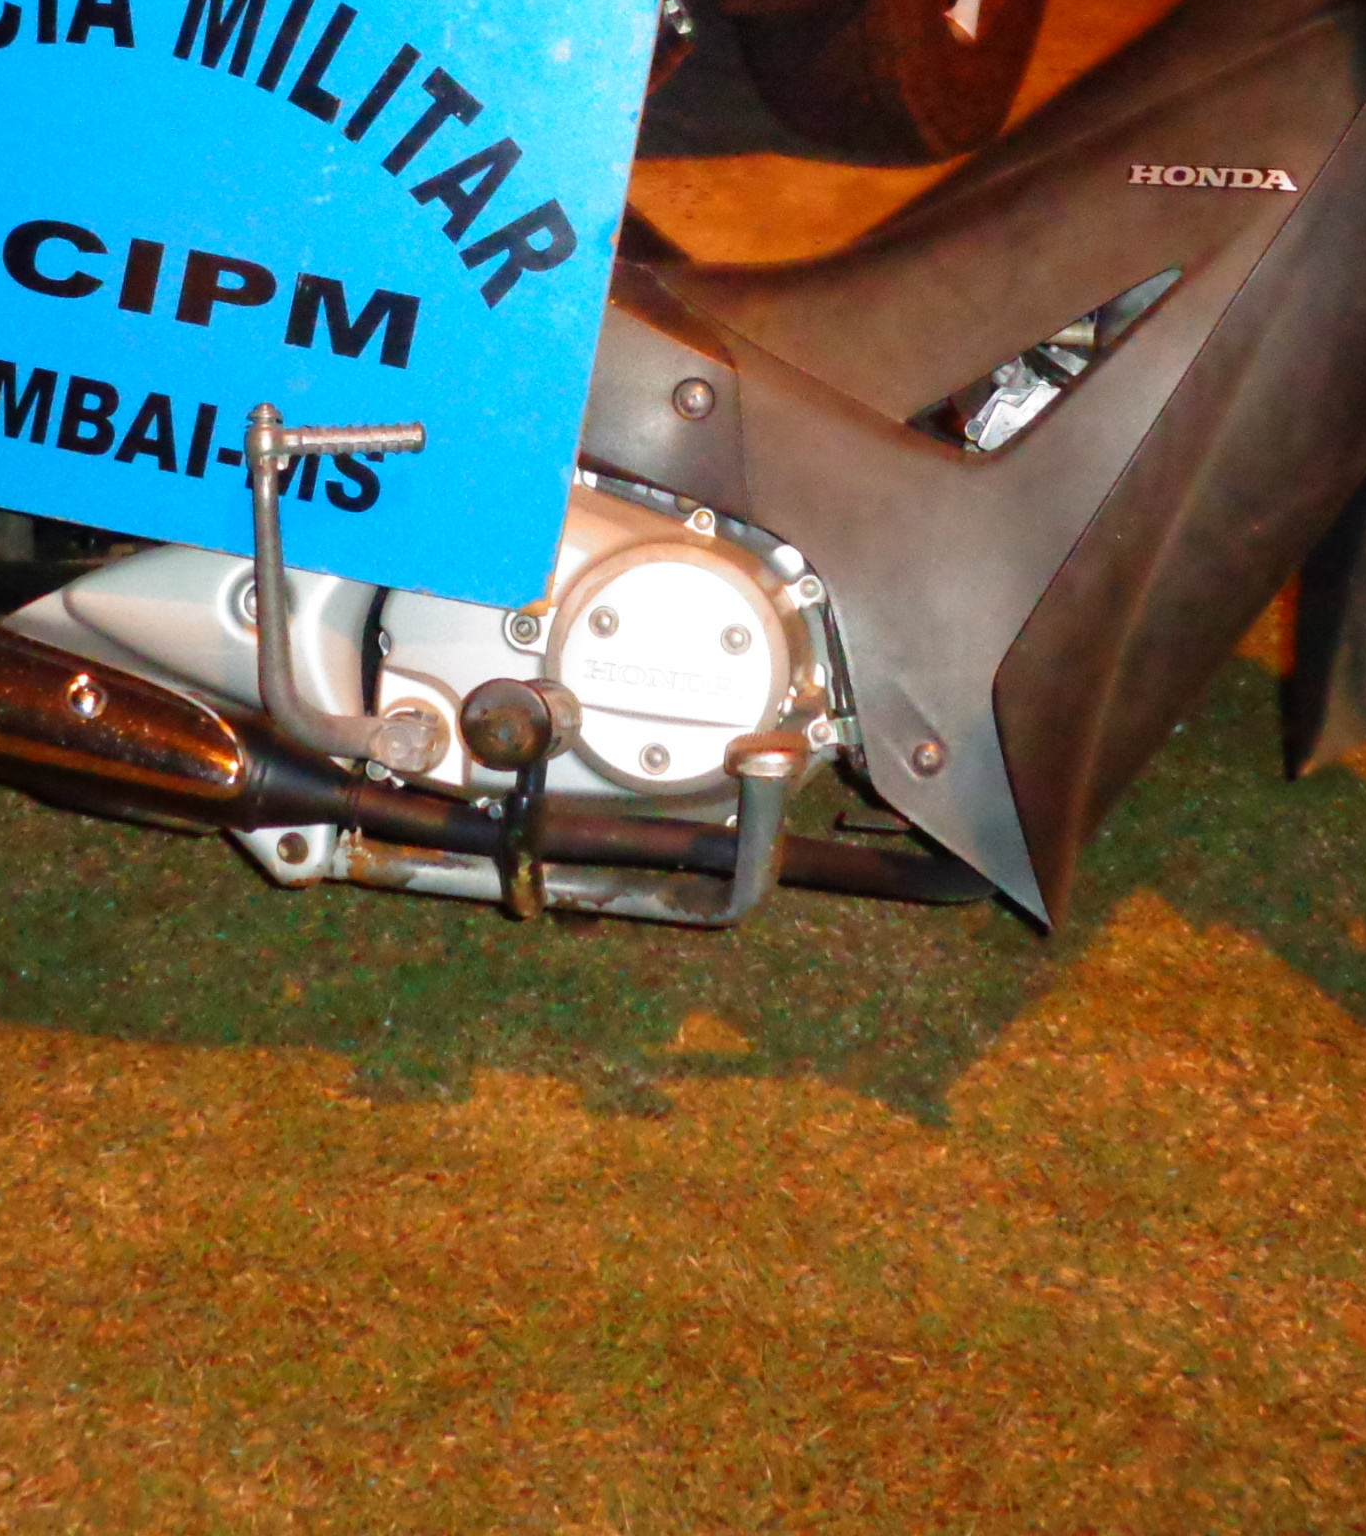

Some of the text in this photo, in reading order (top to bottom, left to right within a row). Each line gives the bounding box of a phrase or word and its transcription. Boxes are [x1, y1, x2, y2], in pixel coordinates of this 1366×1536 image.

[1129, 164, 1297, 191] HONDA
[1, 219, 422, 370] CIPM
[583, 659, 741, 698] HONDA
